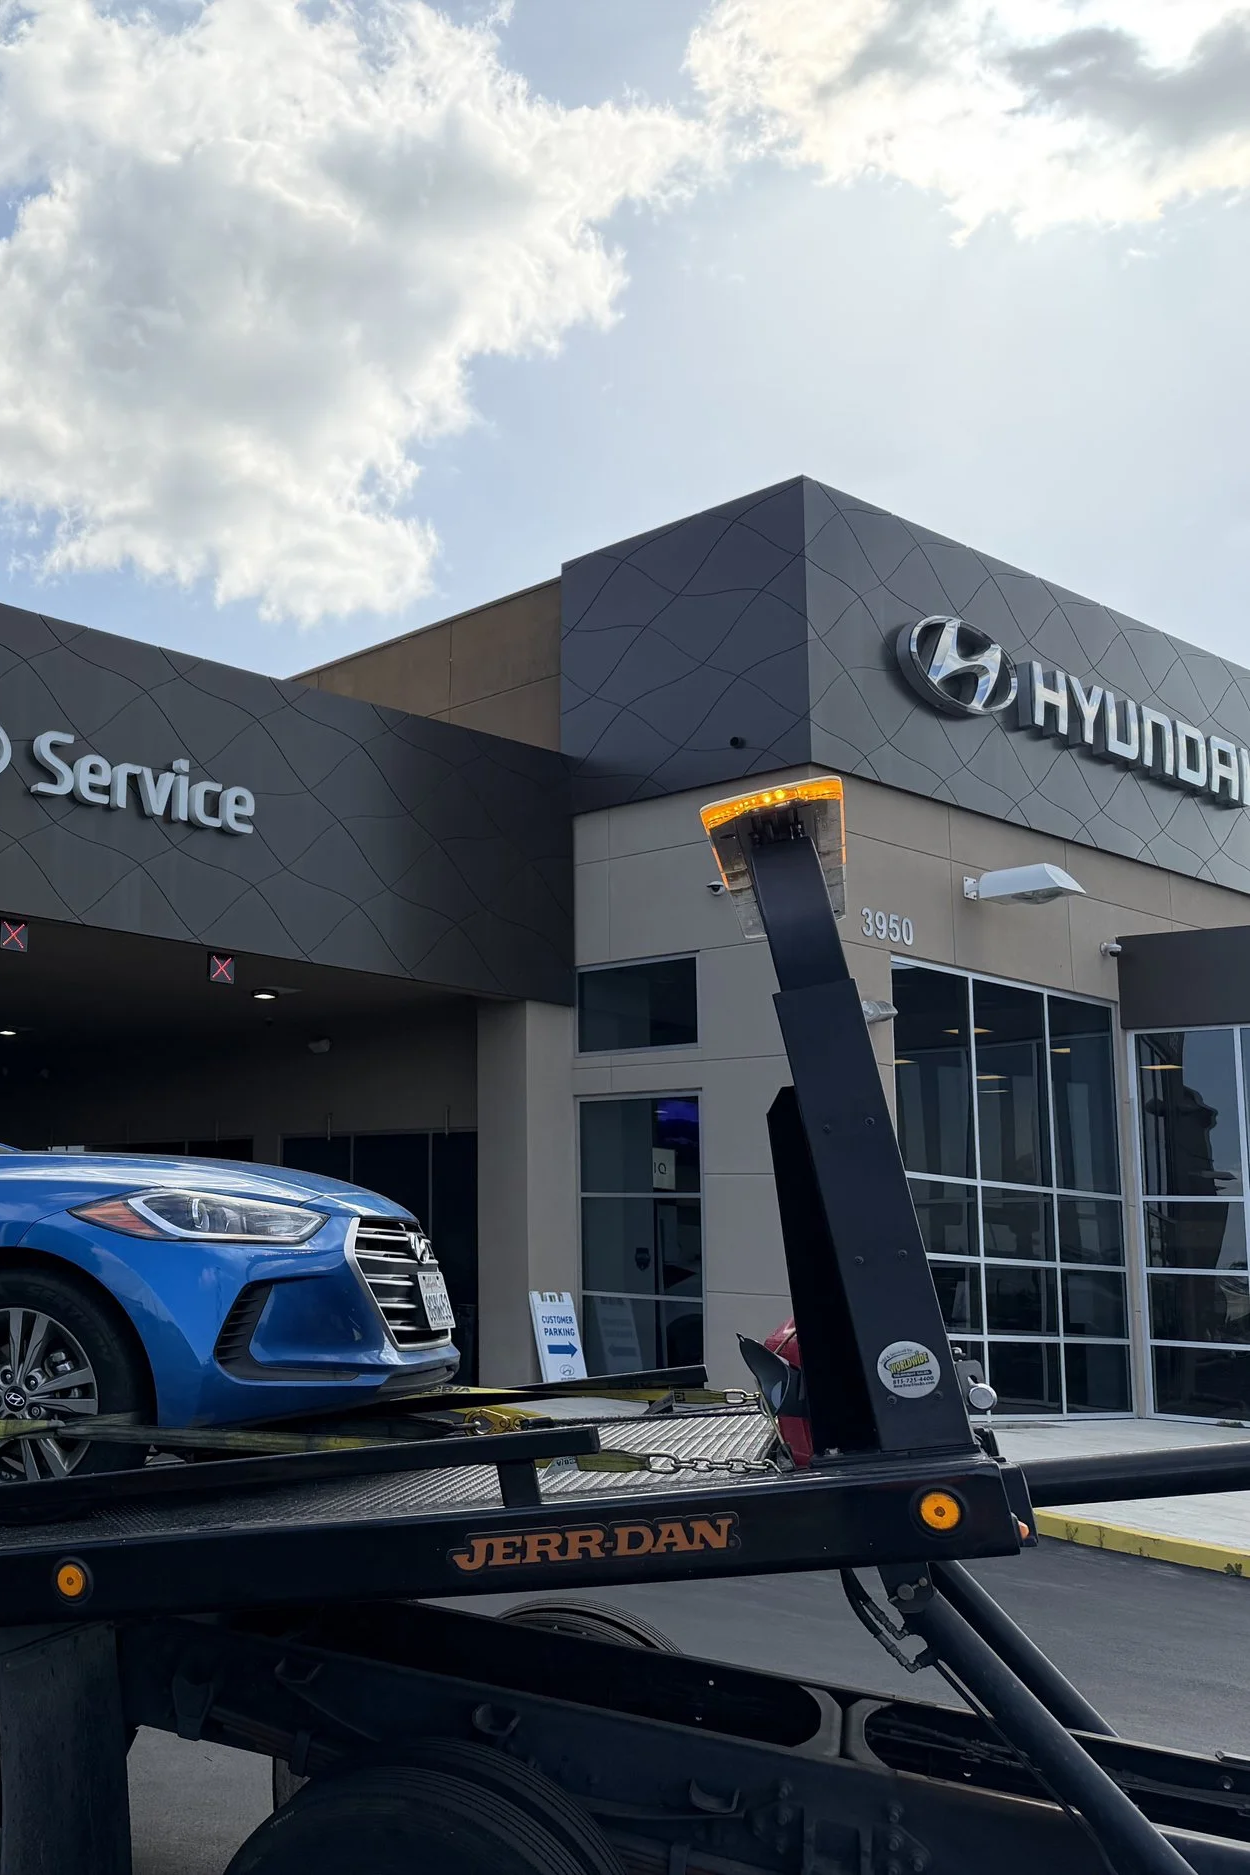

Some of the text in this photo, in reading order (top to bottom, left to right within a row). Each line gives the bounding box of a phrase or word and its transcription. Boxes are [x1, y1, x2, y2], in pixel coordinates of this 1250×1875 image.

[1019, 660, 1250, 806] HYUNDAI
[30, 731, 255, 834] Service
[861, 907, 914, 946] 3950
[541, 1315, 574, 1325] CUSTOMER
[544, 1327, 575, 1337] PARKING
[452, 1518, 734, 1571] JERR-DAN
